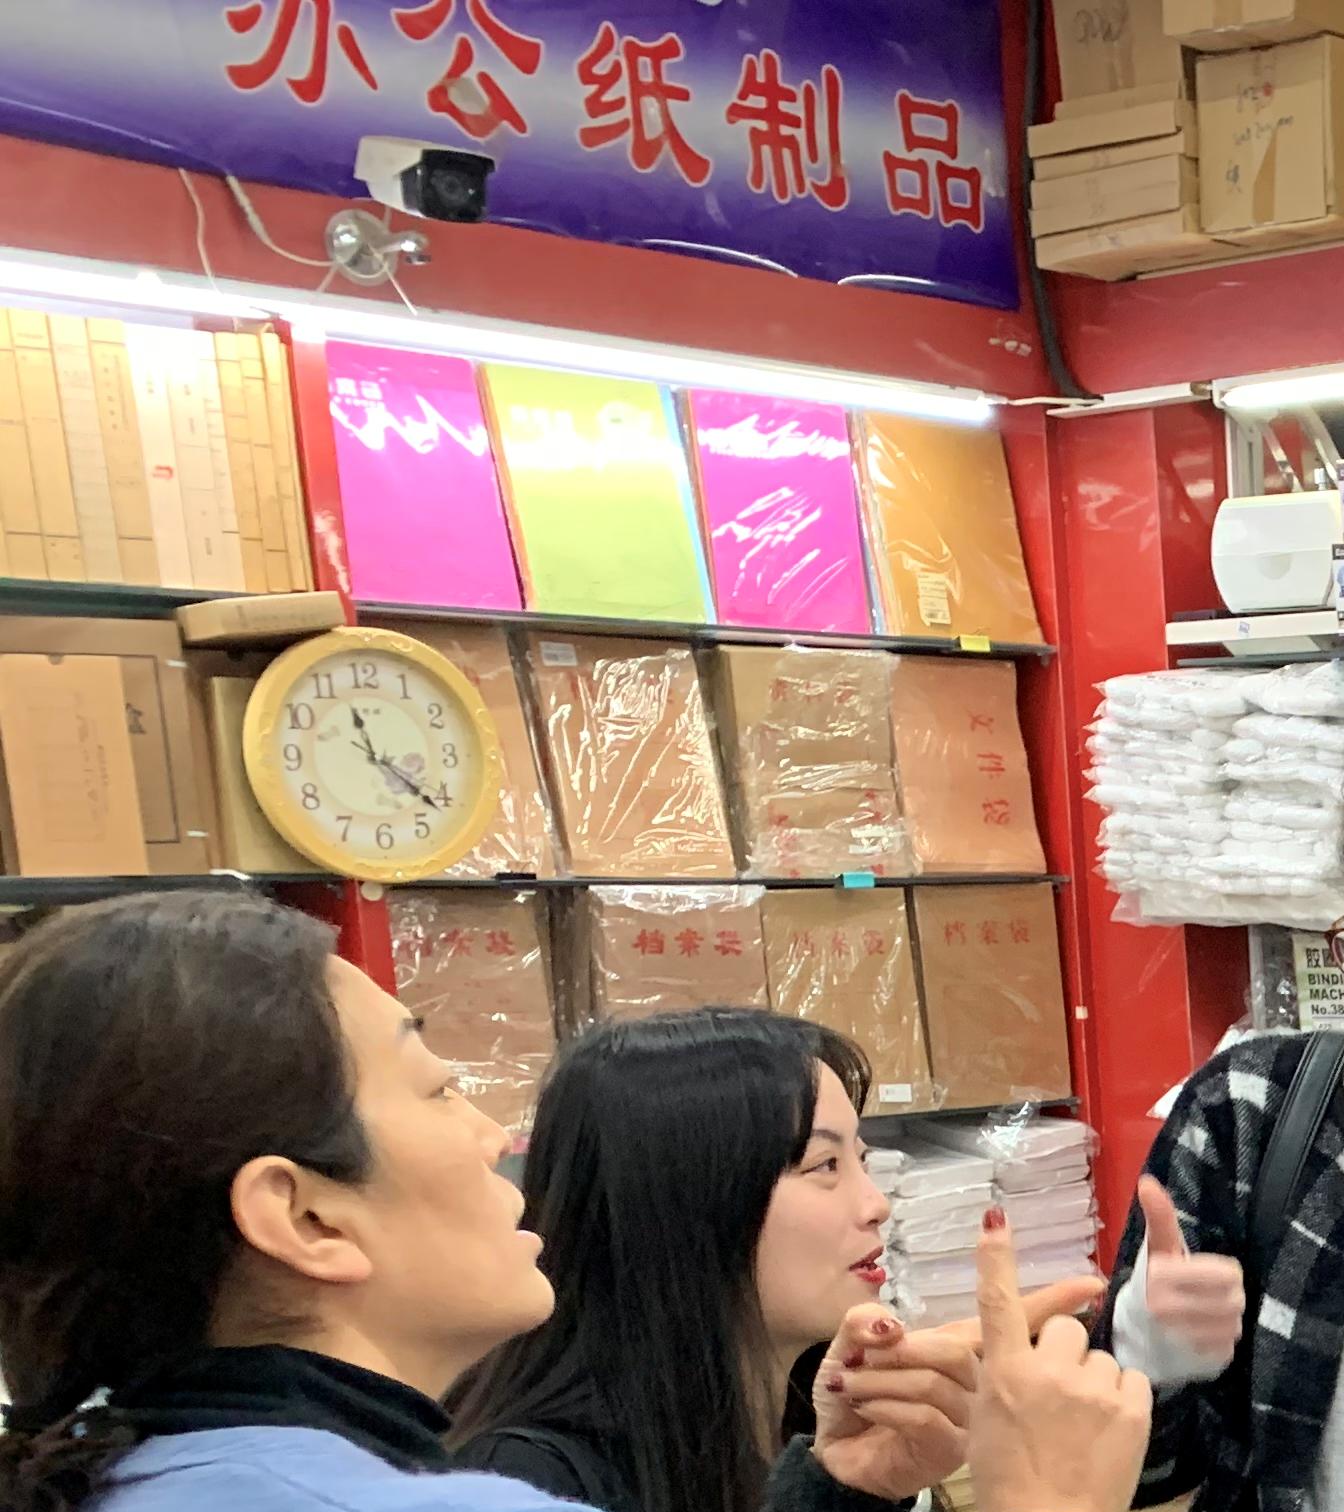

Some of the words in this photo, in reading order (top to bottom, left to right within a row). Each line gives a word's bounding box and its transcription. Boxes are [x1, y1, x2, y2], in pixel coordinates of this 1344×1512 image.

[224, 0, 984, 233] 办公纸制品
[312, 672, 338, 700] 11
[350, 662, 379, 690] 12
[397, 673, 412, 700] 1
[286, 702, 315, 730] 10
[427, 703, 445, 730] 2
[283, 744, 303, 771] 9
[442, 743, 458, 768] 3
[301, 783, 320, 810] 8
[336, 815, 353, 842] 7
[376, 823, 394, 850] 6
[414, 812, 430, 839] 5
